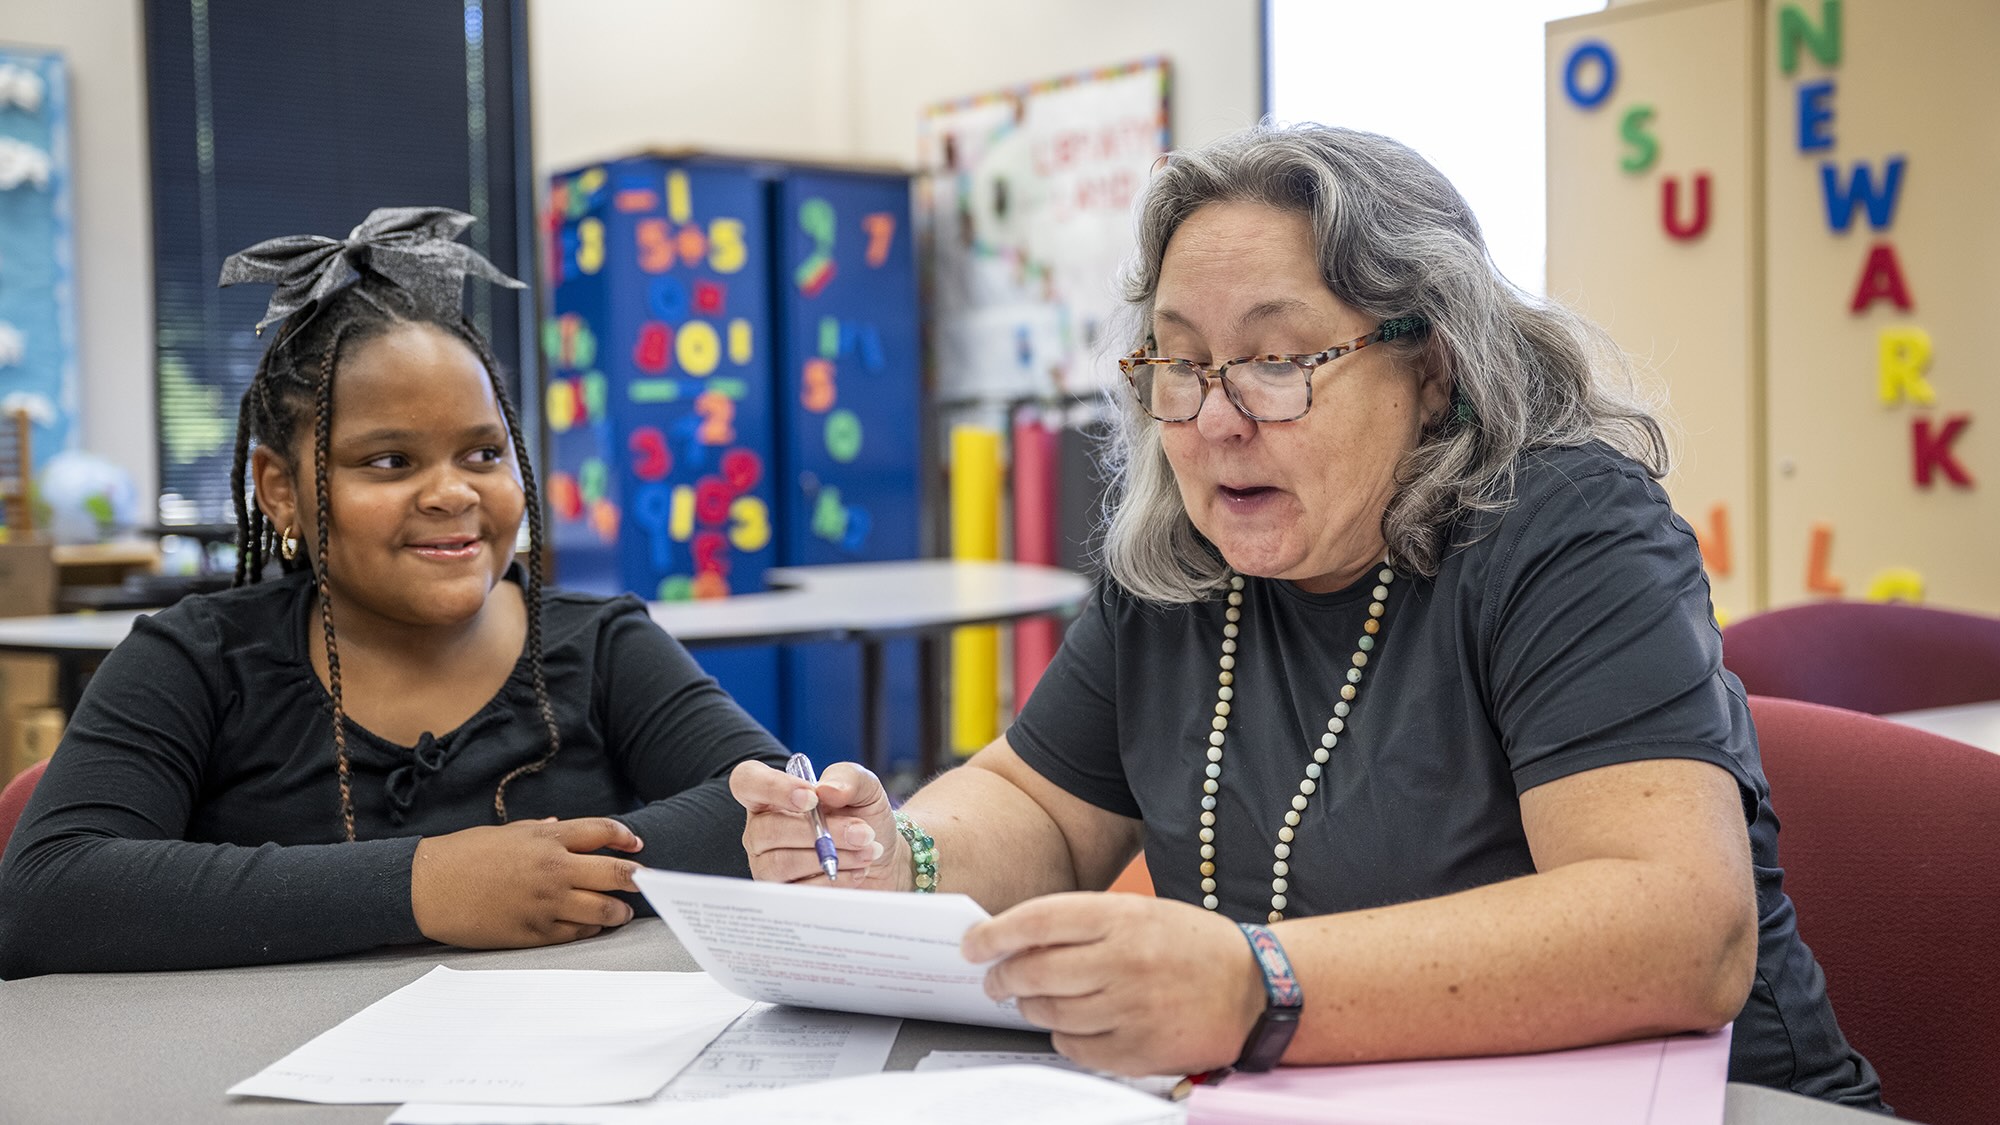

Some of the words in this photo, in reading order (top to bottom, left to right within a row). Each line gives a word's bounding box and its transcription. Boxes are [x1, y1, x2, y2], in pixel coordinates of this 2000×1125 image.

[1562, 40, 1713, 241] OSU
[1779, 0, 1975, 490] NEWARK
[730, 496, 771, 552] 3
[1807, 523, 1844, 594] L
